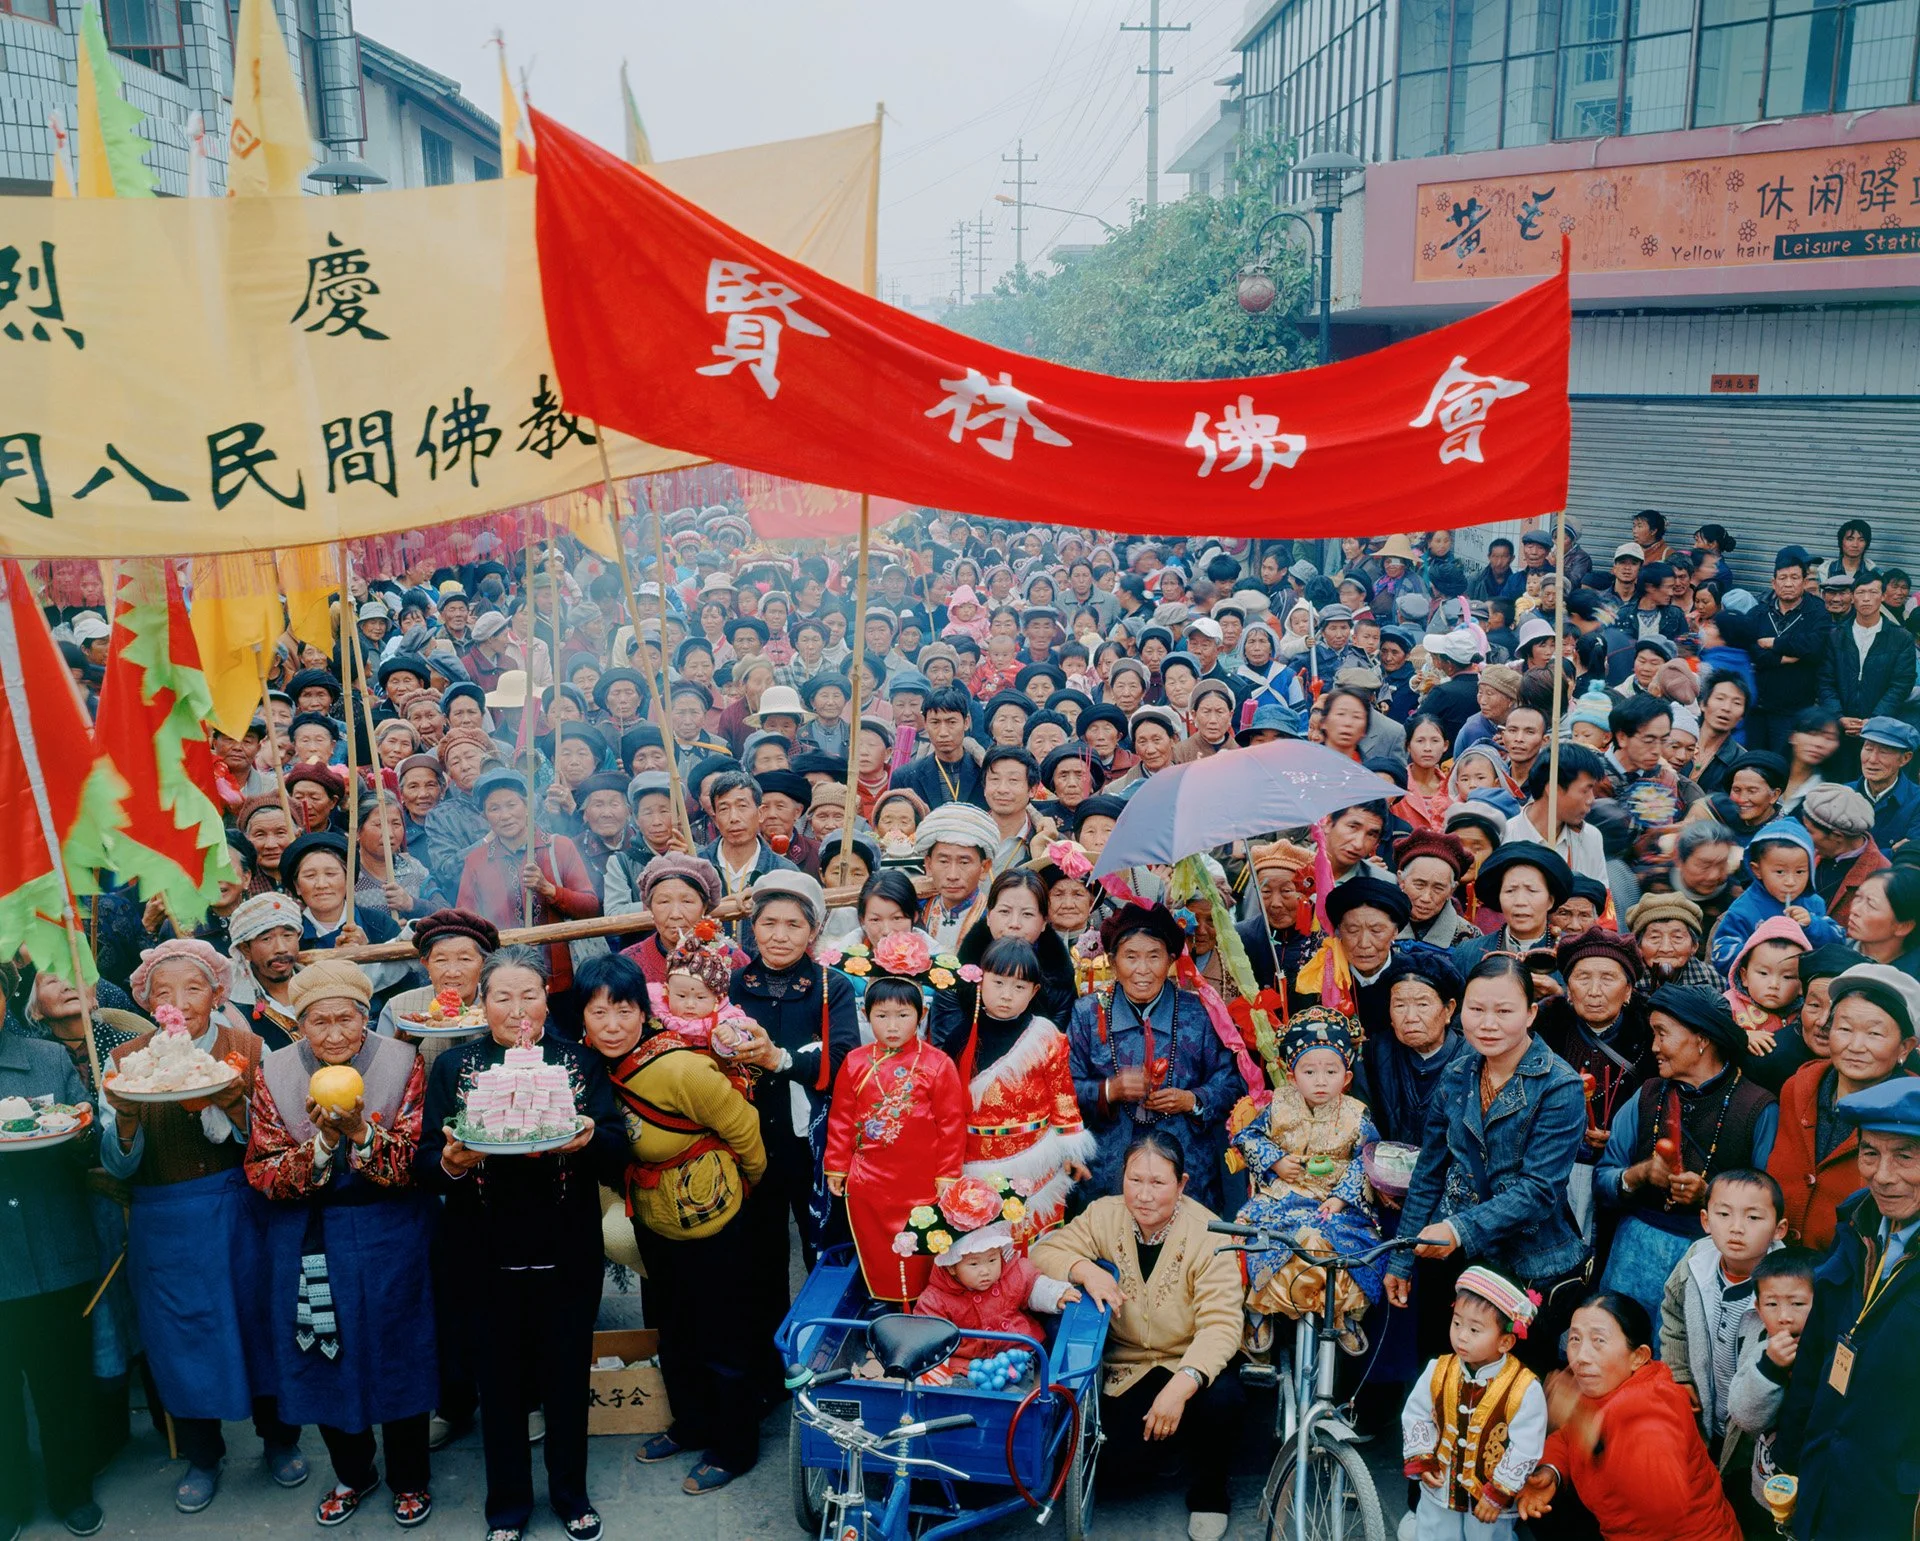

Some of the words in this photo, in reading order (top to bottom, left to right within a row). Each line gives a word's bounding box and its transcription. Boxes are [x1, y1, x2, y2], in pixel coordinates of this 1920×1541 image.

[1672, 246, 1725, 262] Yellow
[1737, 243, 1771, 258] hair
[1782, 237, 1851, 256] Leisure
